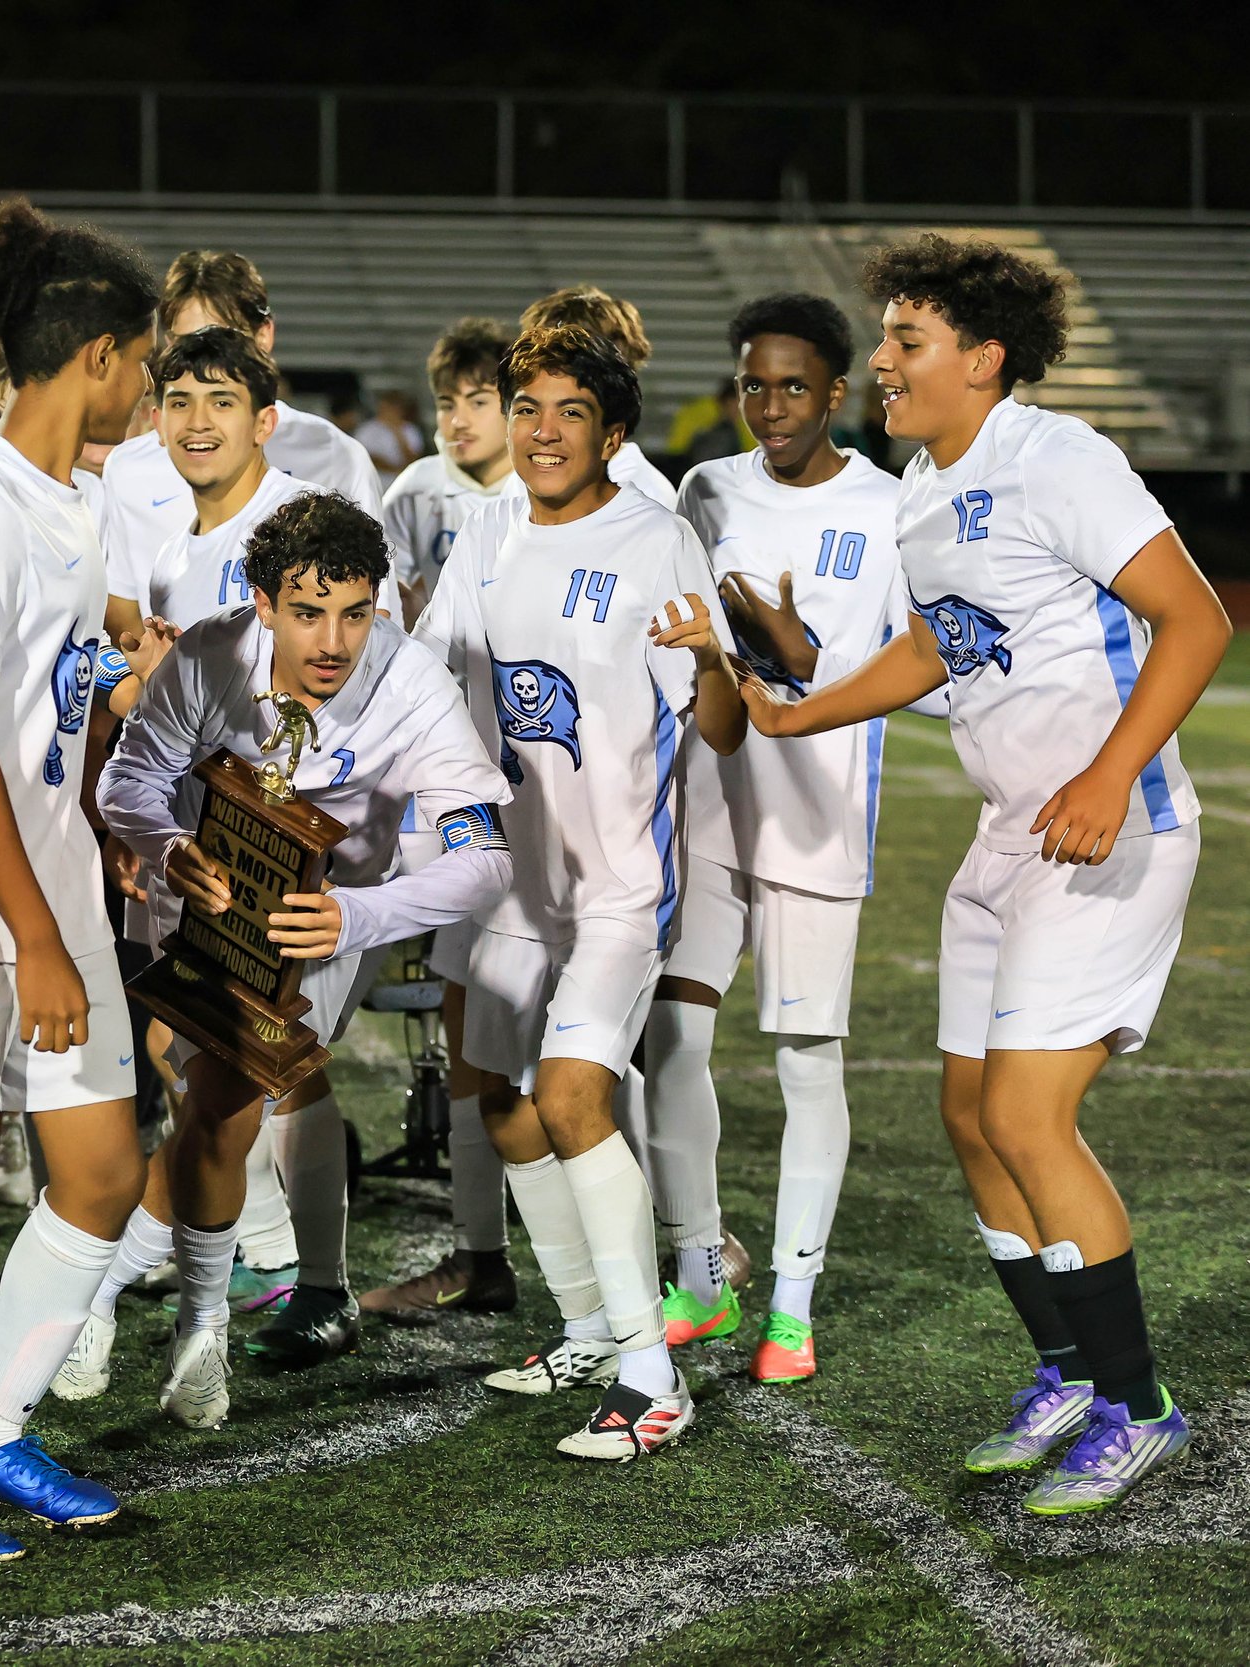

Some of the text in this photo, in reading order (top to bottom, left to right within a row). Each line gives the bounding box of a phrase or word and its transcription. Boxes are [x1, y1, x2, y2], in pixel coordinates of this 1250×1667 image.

[952, 489, 993, 544] 12
[815, 529, 866, 580] 10
[562, 568, 618, 623] 14
[328, 748, 355, 787] 7
[209, 793, 301, 872] WATERFORD
[442, 818, 473, 851] C
[228, 873, 260, 912] VS
[236, 847, 290, 898] MOTT
[184, 915, 277, 997] CHAMPIONSHIP
[220, 908, 283, 964] KETTERING
